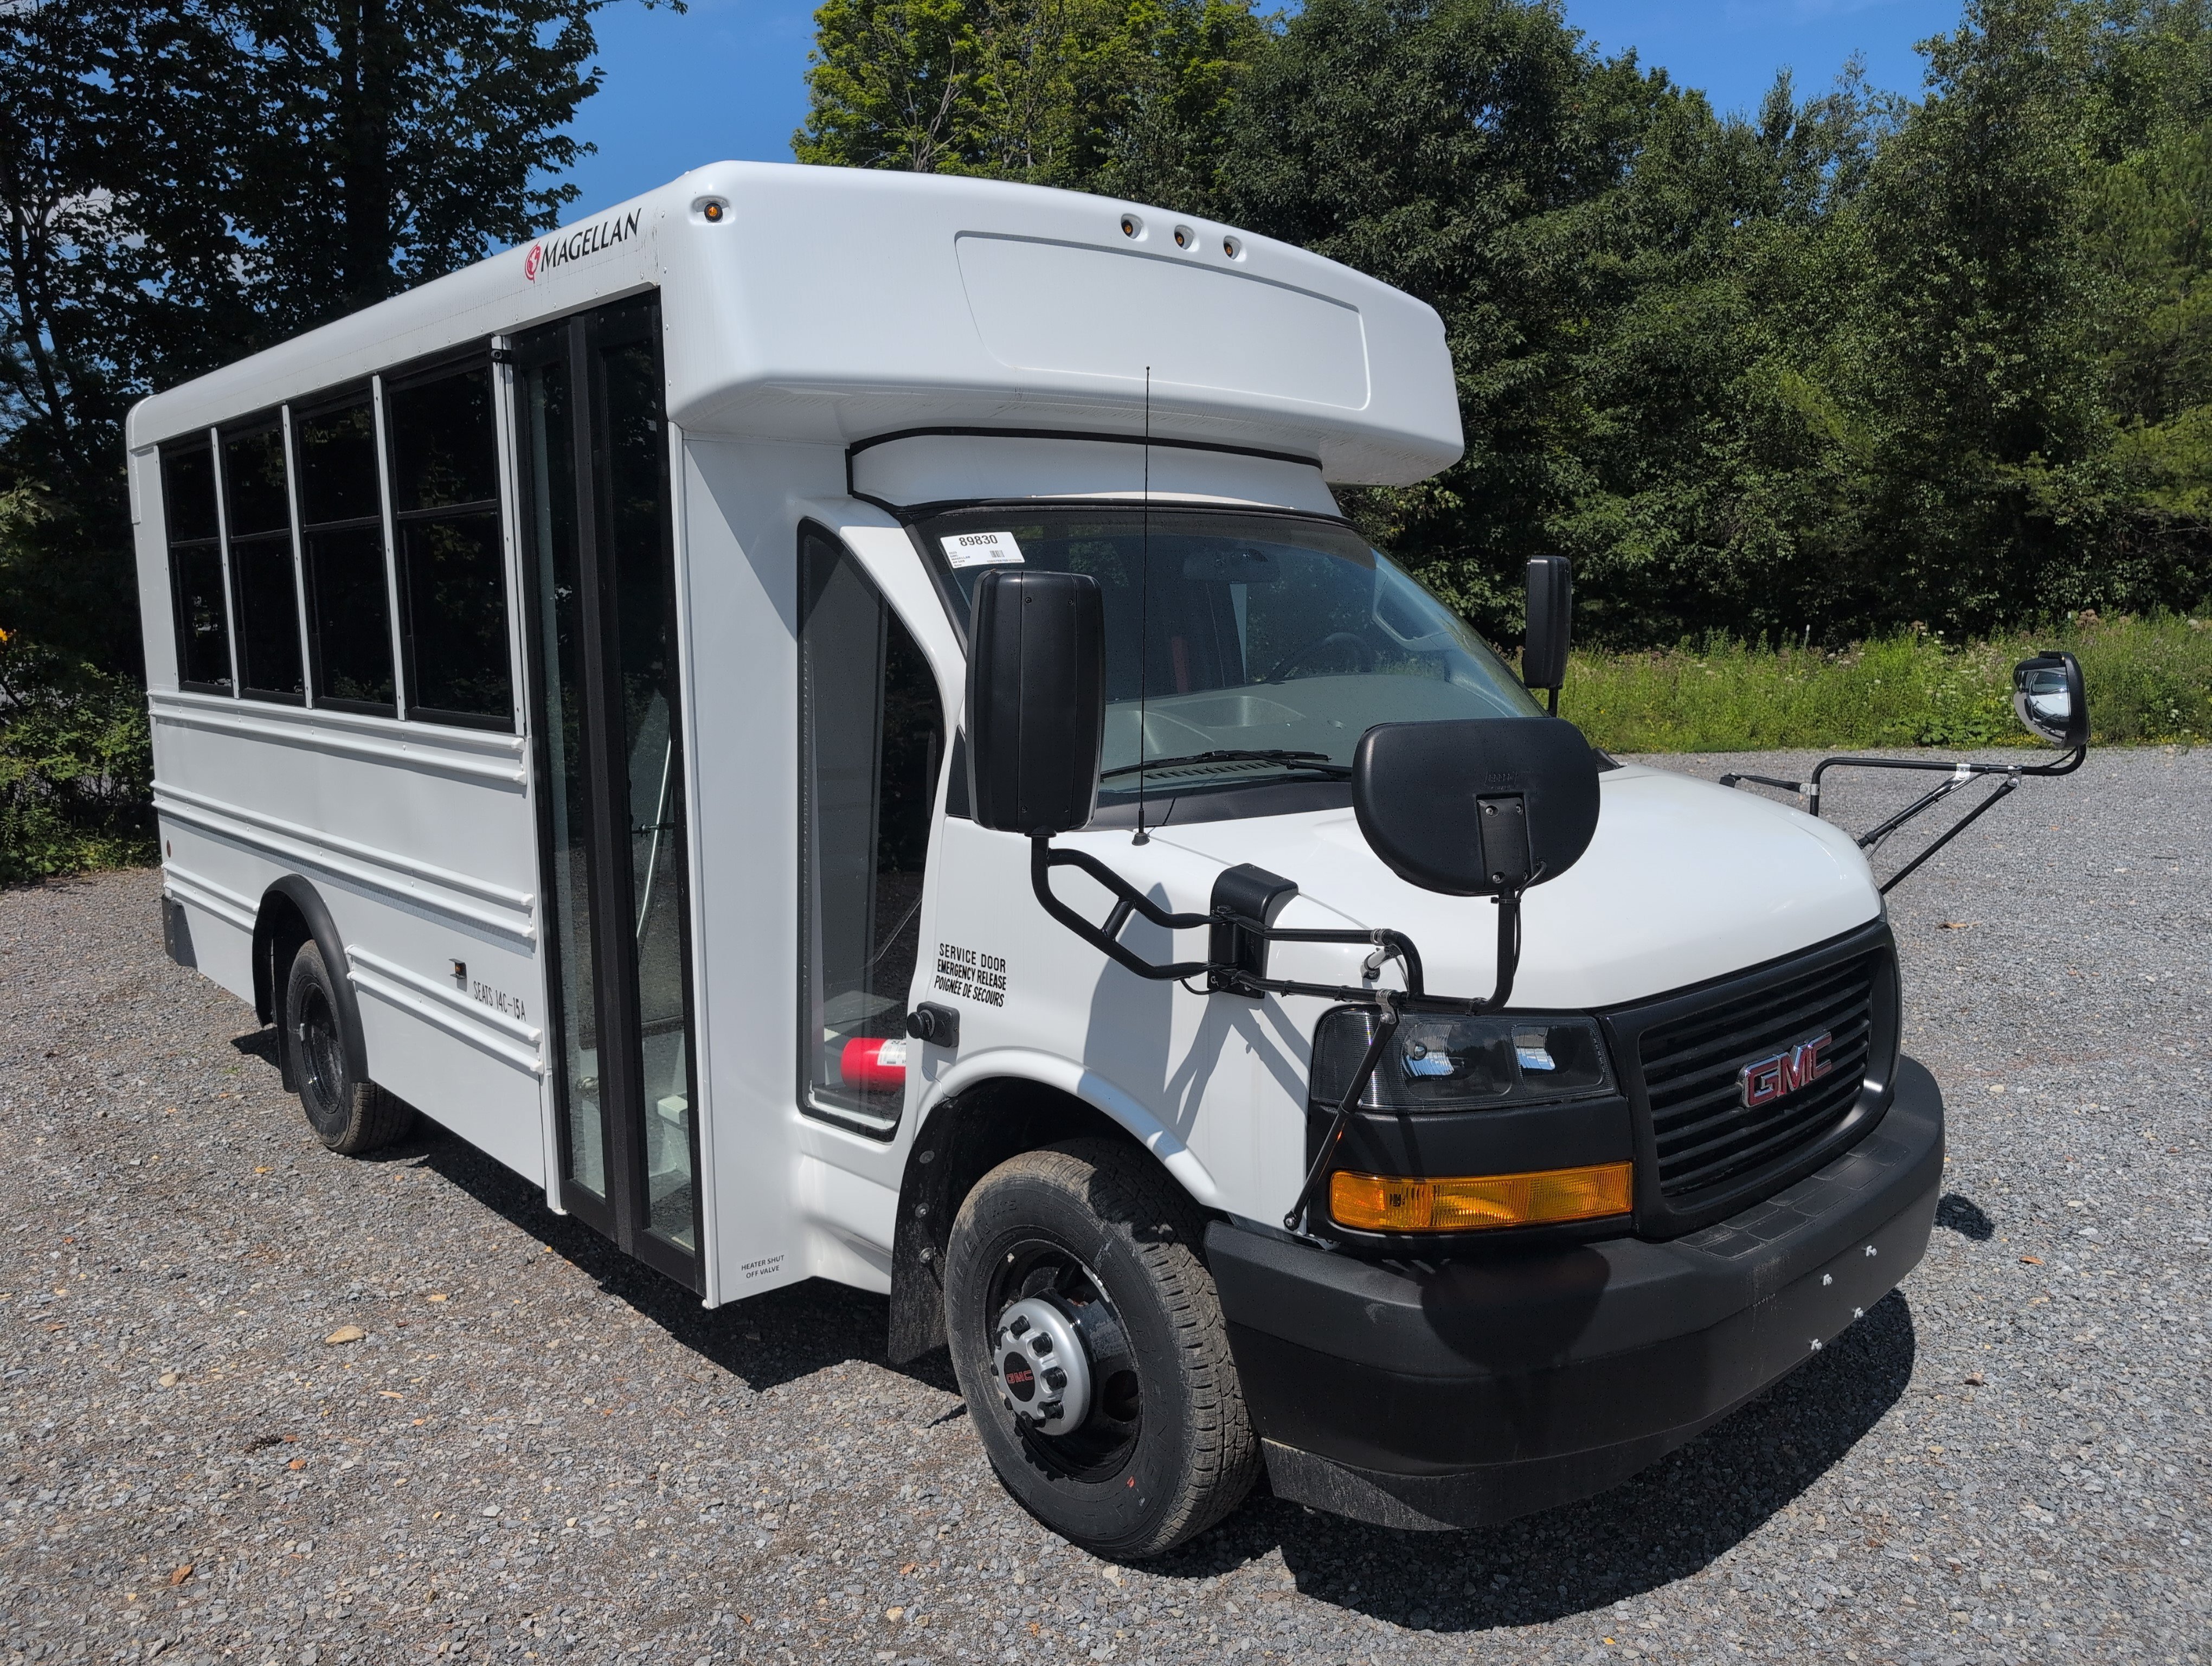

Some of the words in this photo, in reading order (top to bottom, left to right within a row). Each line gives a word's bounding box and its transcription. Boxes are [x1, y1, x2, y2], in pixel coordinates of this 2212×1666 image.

[541, 208, 641, 272] MAGELLAN
[959, 534, 998, 547] 89830
[939, 943, 976, 965] SERVICE
[981, 953, 1006, 973] DOOR
[937, 958, 976, 982] EMERGENCY
[977, 970, 1007, 991] RELEASE
[473, 980, 493, 1007] SEATS
[496, 990, 526, 1022] 14C-15A
[934, 975, 962, 996] POIGNÉE
[962, 983, 972, 998] DE
[973, 986, 1005, 1008] SECOURS
[1741, 1031, 1832, 1107] GMC
[741, 1259, 766, 1271] HEATER
[767, 1254, 785, 1265] SHUT
[746, 1270, 759, 1278] OFF
[760, 1265, 780, 1275] VALVE
[1006, 1369, 1034, 1384] GMC
